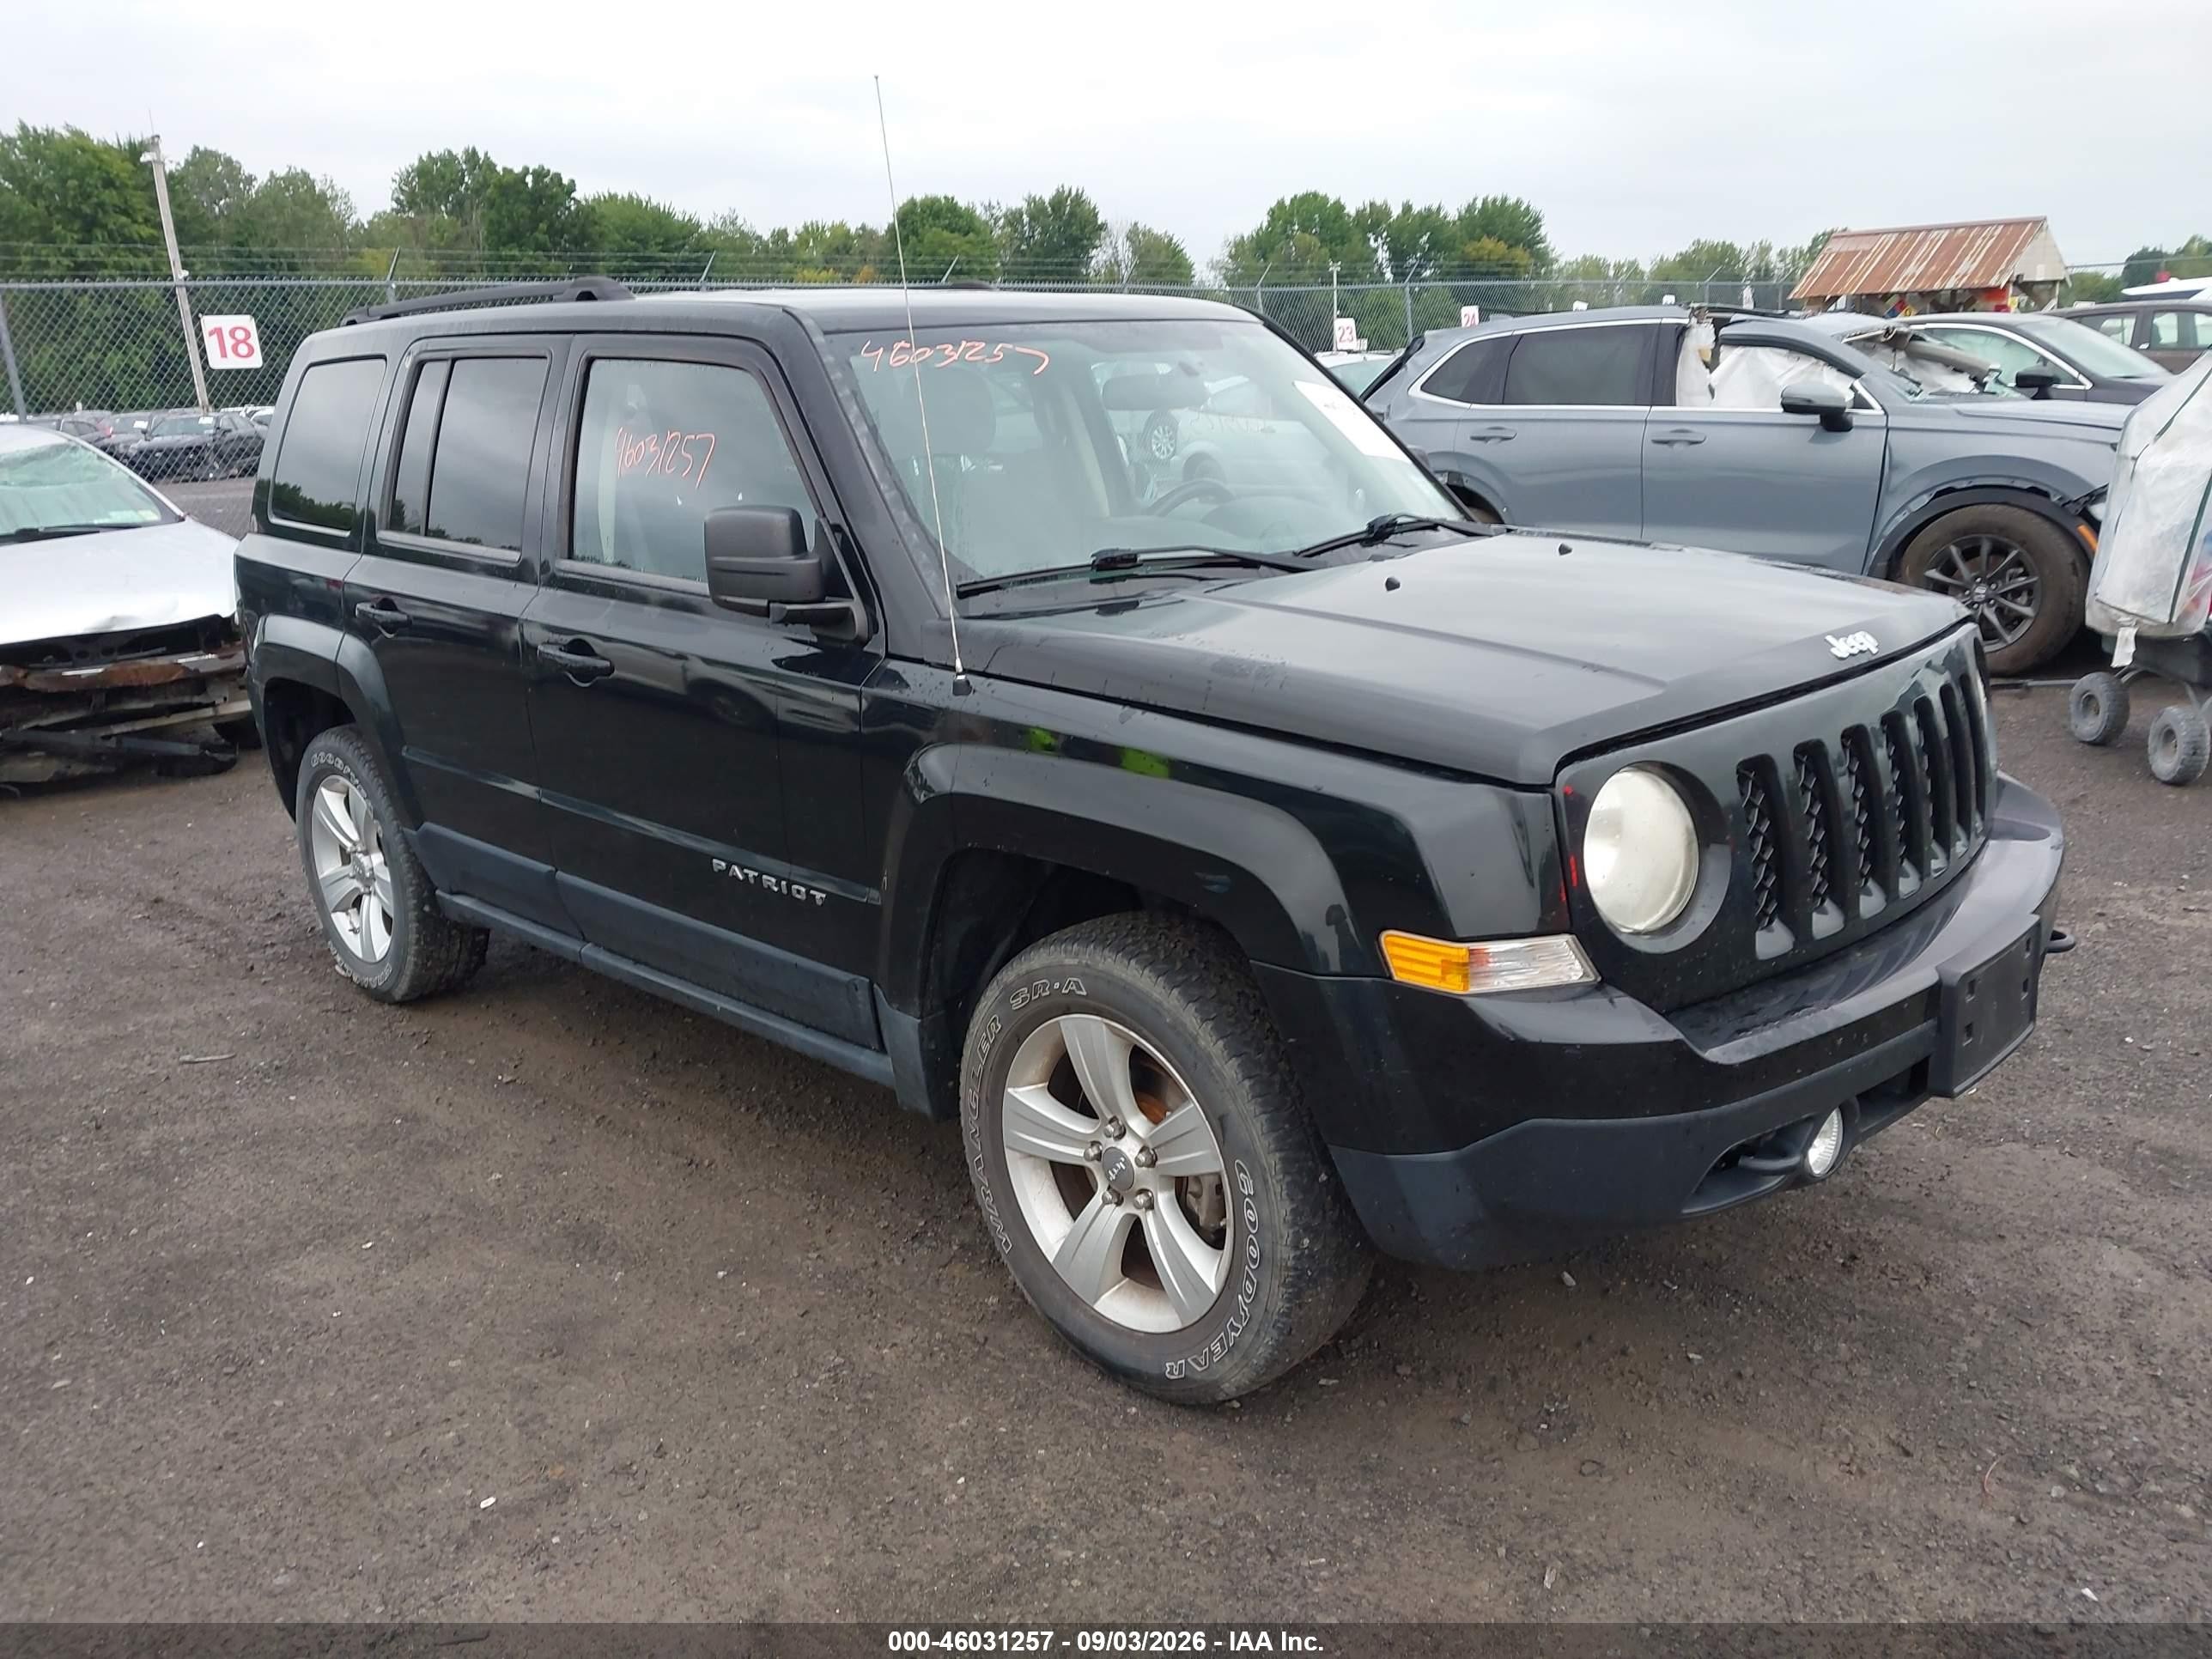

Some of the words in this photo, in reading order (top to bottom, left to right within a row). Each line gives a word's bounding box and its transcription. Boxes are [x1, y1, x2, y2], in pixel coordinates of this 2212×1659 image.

[208, 326, 255, 358] 18
[1337, 325, 1354, 343] 23
[1825, 631, 1879, 659] Jeep
[712, 858, 827, 907] PATRIOT
[968, 1014, 1012, 1254] WRANGLER
[1165, 1159, 1261, 1379] GOODYEAR
